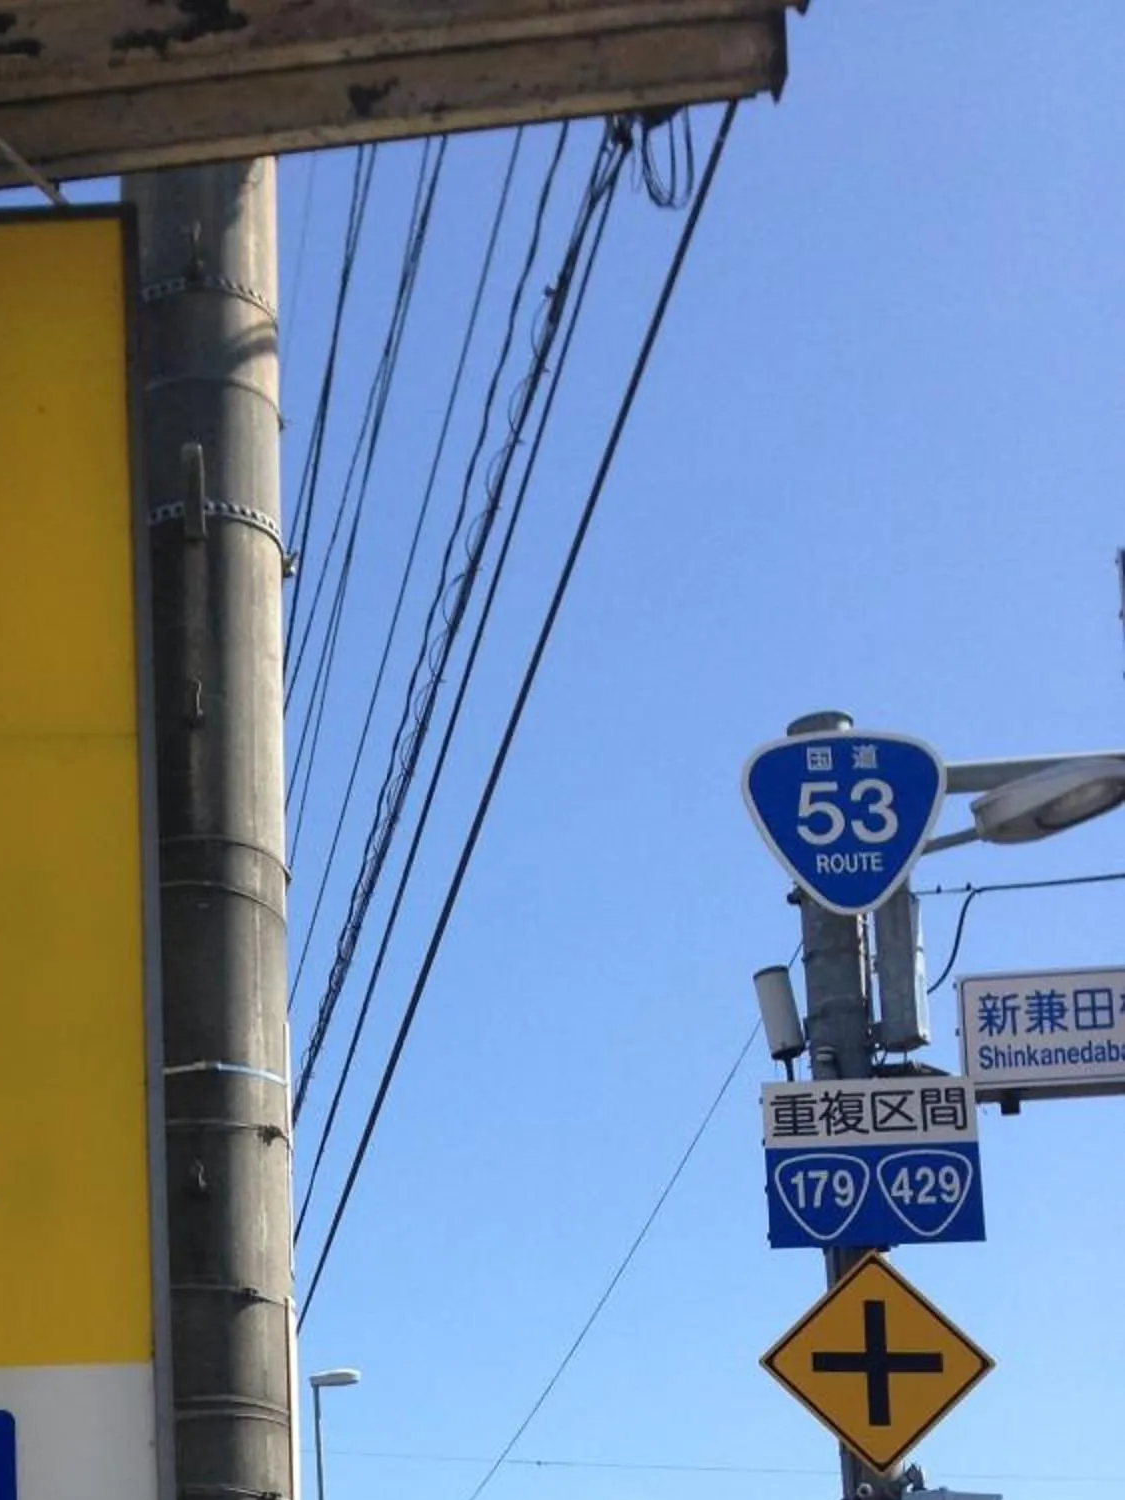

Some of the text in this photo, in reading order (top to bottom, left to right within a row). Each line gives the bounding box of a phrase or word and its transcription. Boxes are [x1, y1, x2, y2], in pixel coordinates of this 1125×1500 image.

[797, 778, 898, 845] 53
[816, 852, 883, 873] ROUTE
[978, 988, 1125, 1036] 新兼田
[770, 1086, 969, 1137] 重複区間
[791, 1169, 855, 1209] 179
[890, 1165, 962, 1206] 429
